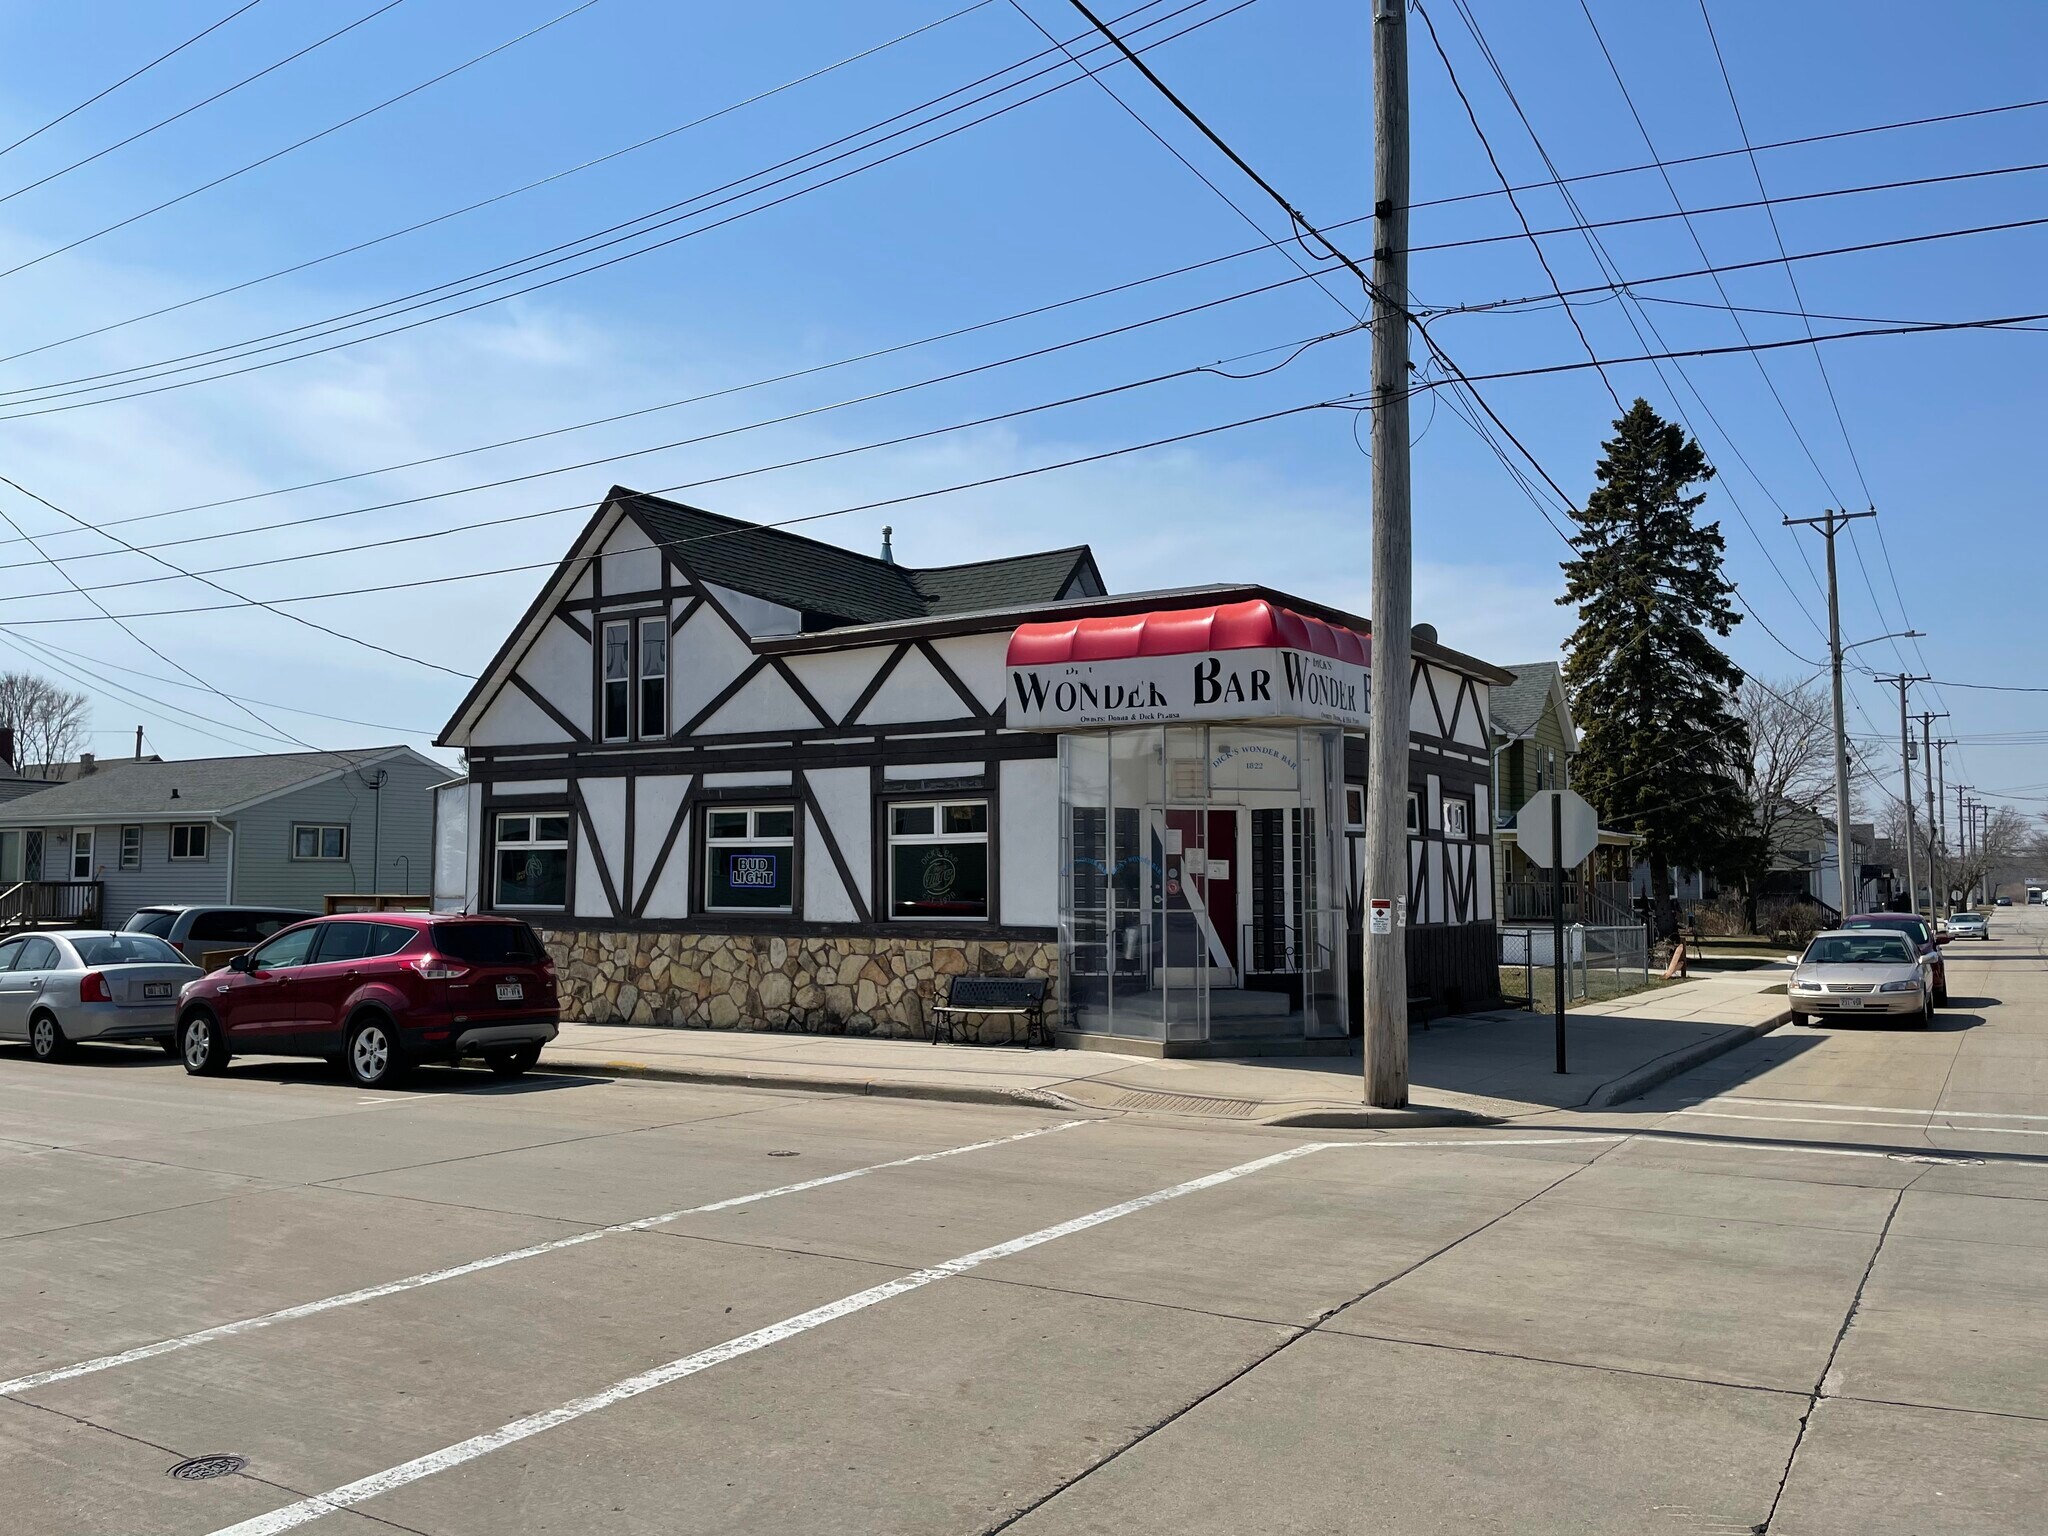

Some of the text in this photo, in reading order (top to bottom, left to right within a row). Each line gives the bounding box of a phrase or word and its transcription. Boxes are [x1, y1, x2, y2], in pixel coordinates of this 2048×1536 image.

[1194, 657, 1271, 707] BAR
[1281, 651, 1357, 712] WONDER
[1212, 745, 1297, 770] DICK'S WONDER BAR
[738, 858, 767, 871] BUD
[733, 871, 773, 884] LIGHT
